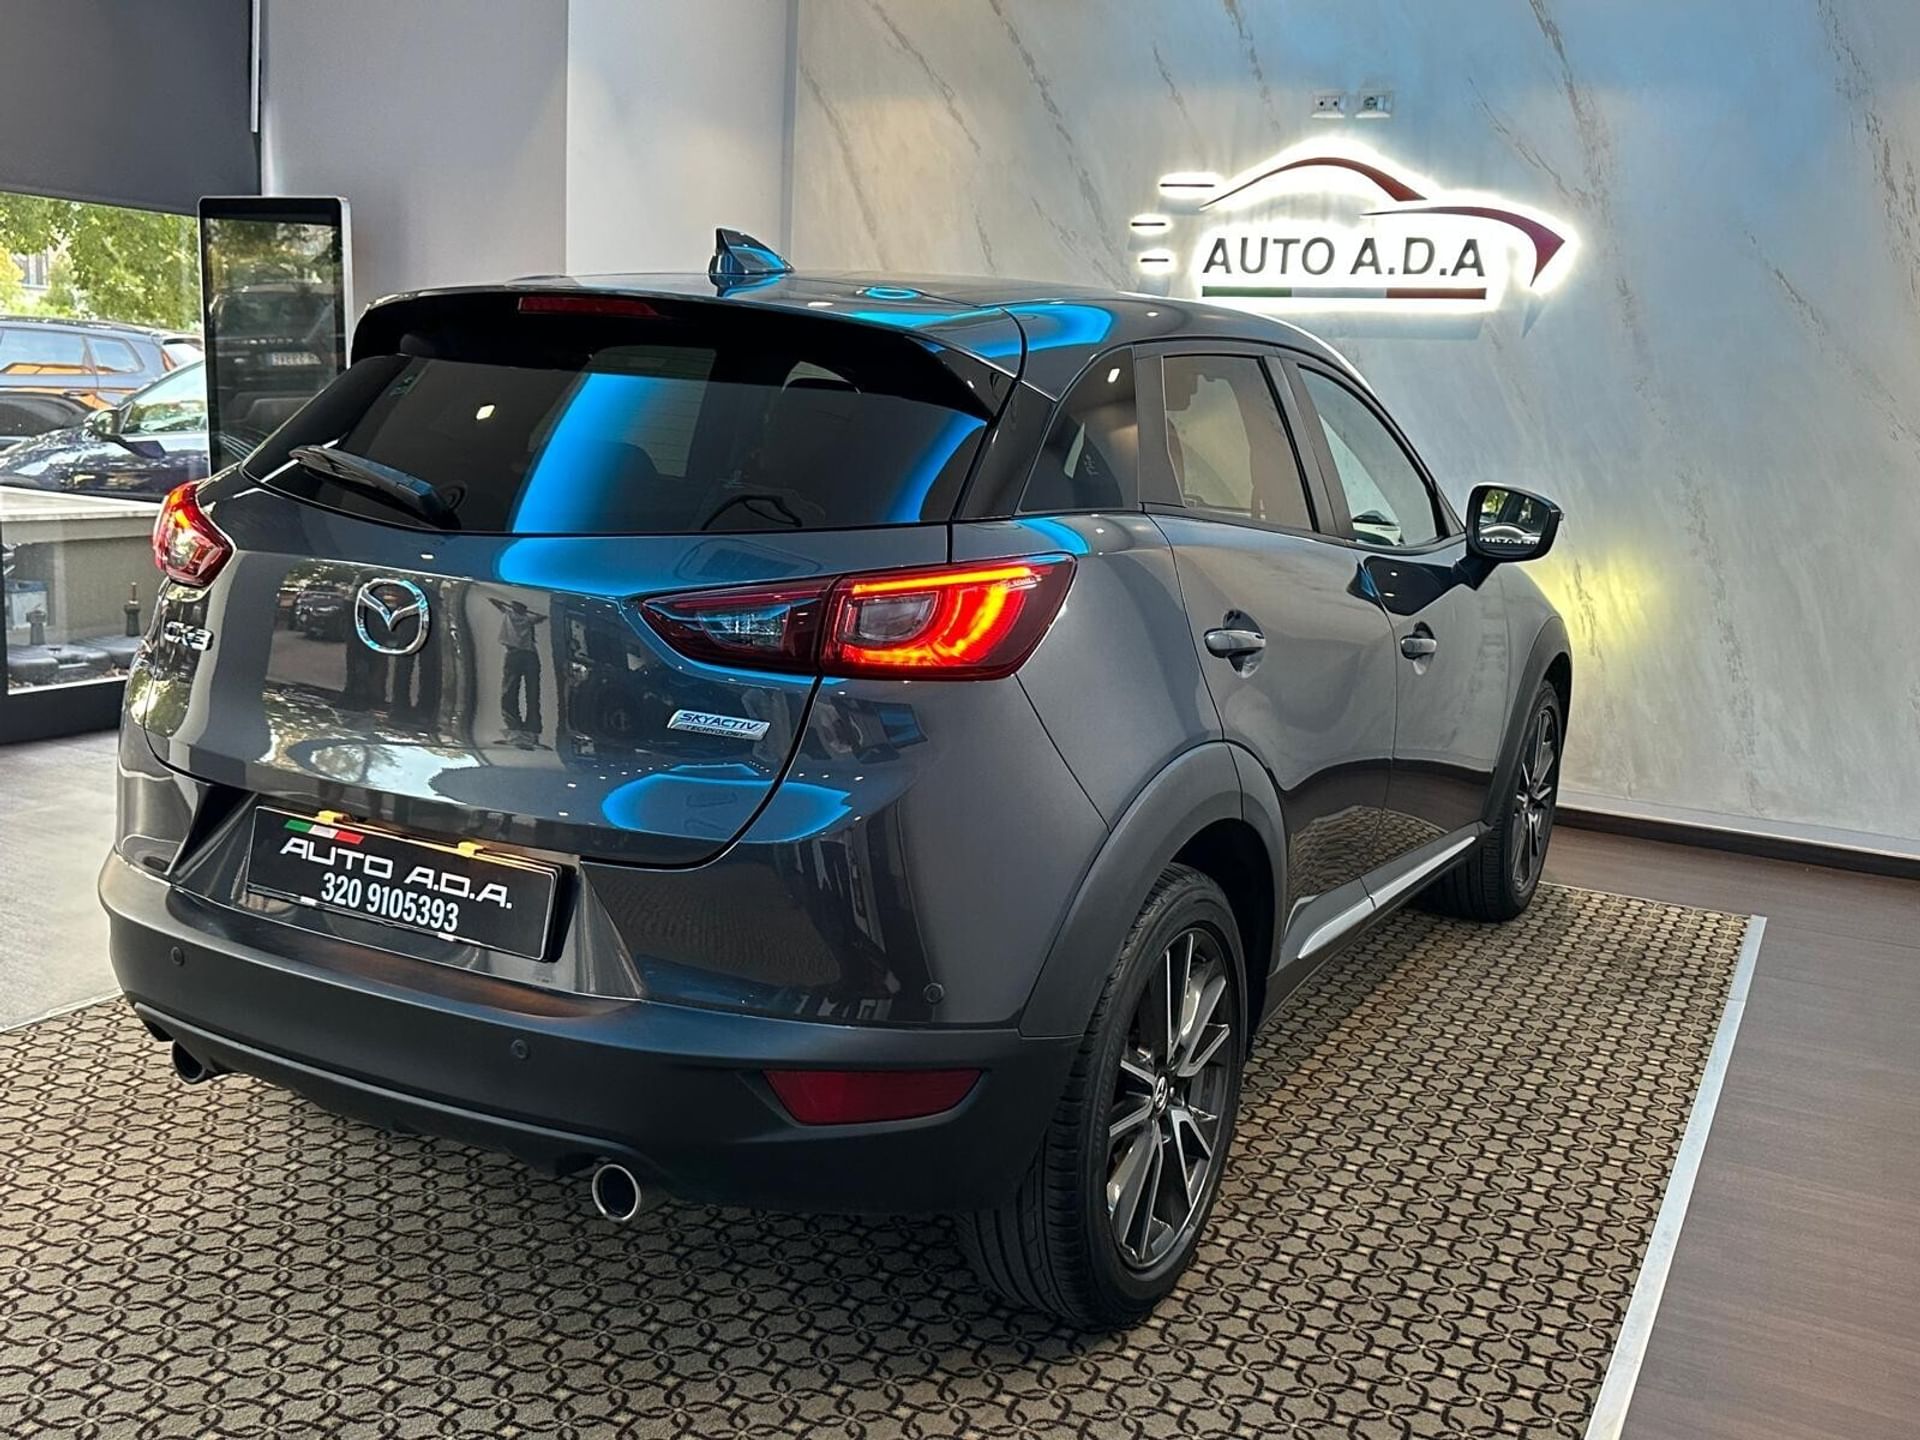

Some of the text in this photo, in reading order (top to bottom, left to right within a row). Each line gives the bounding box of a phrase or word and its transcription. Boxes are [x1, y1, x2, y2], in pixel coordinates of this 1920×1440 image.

[1202, 237, 1486, 276] AUTO A.D.A
[680, 712, 760, 730] SKYACTIV
[279, 836, 514, 910] AUTO A.D.A.
[320, 872, 460, 933] 320 9105393
